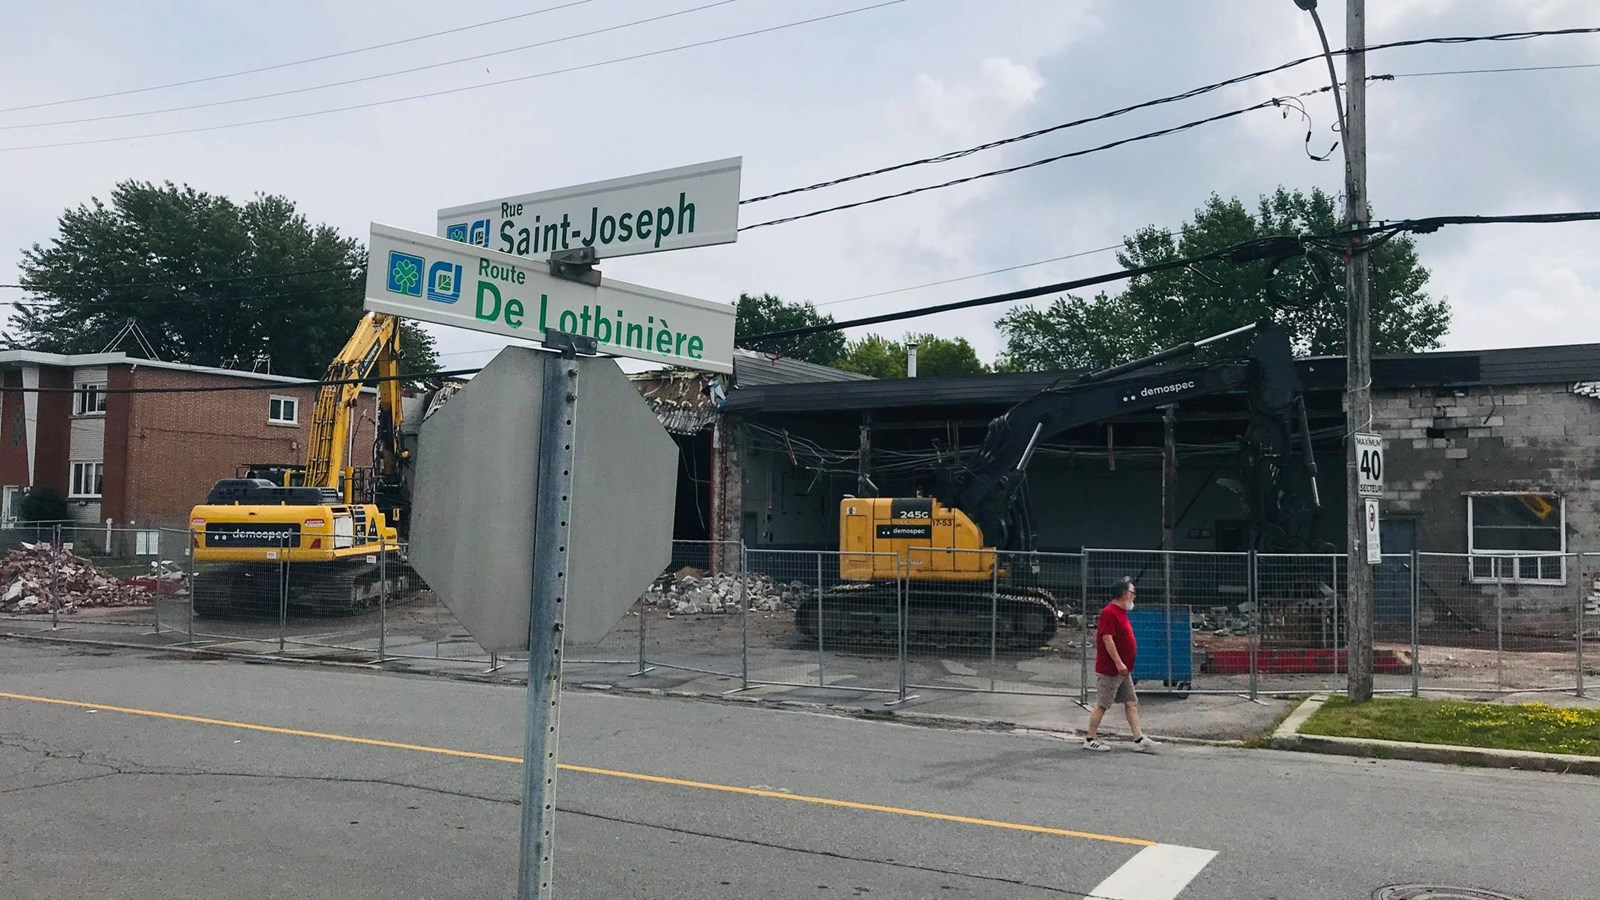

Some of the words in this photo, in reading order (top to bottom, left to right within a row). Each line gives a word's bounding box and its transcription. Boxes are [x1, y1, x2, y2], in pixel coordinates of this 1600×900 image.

[500, 202, 524, 219] Rue
[498, 192, 696, 256] Saint-Joseph
[478, 257, 526, 285] Route
[475, 280, 525, 329] De
[538, 293, 704, 361] Lotbinière
[1140, 381, 1195, 397] demospec
[1355, 437, 1381, 446] MAXIMUM
[1360, 449, 1381, 481] 40
[1359, 484, 1383, 493] SECTEUR
[900, 510, 929, 519] 245G
[232, 528, 290, 541] demospec
